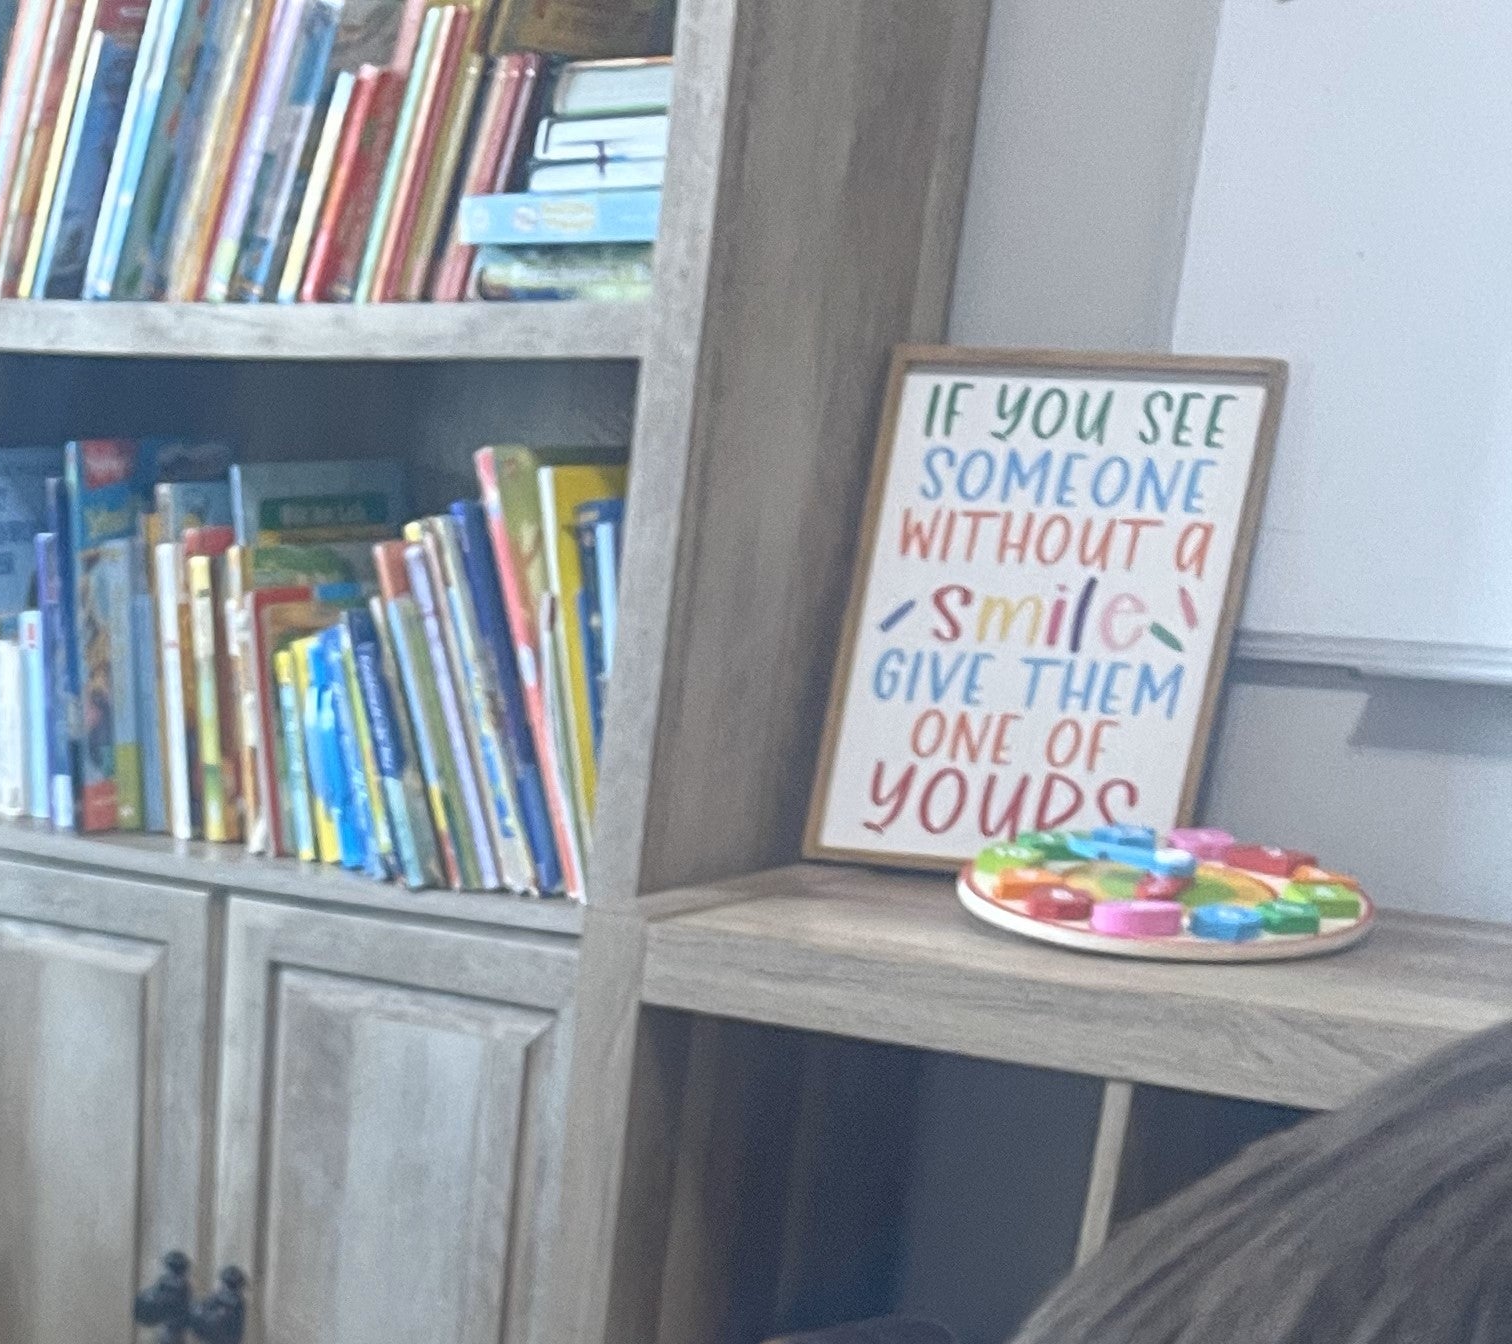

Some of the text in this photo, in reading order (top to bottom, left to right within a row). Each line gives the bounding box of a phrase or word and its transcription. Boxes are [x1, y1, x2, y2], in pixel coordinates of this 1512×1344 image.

[923, 382, 1239, 449] IF YOU SEE
[919, 446, 1218, 515] SOMEONE
[897, 508, 1164, 573] WITHOUT
[871, 648, 1185, 720] GIVE THEM
[910, 708, 1121, 773] ONE OF
